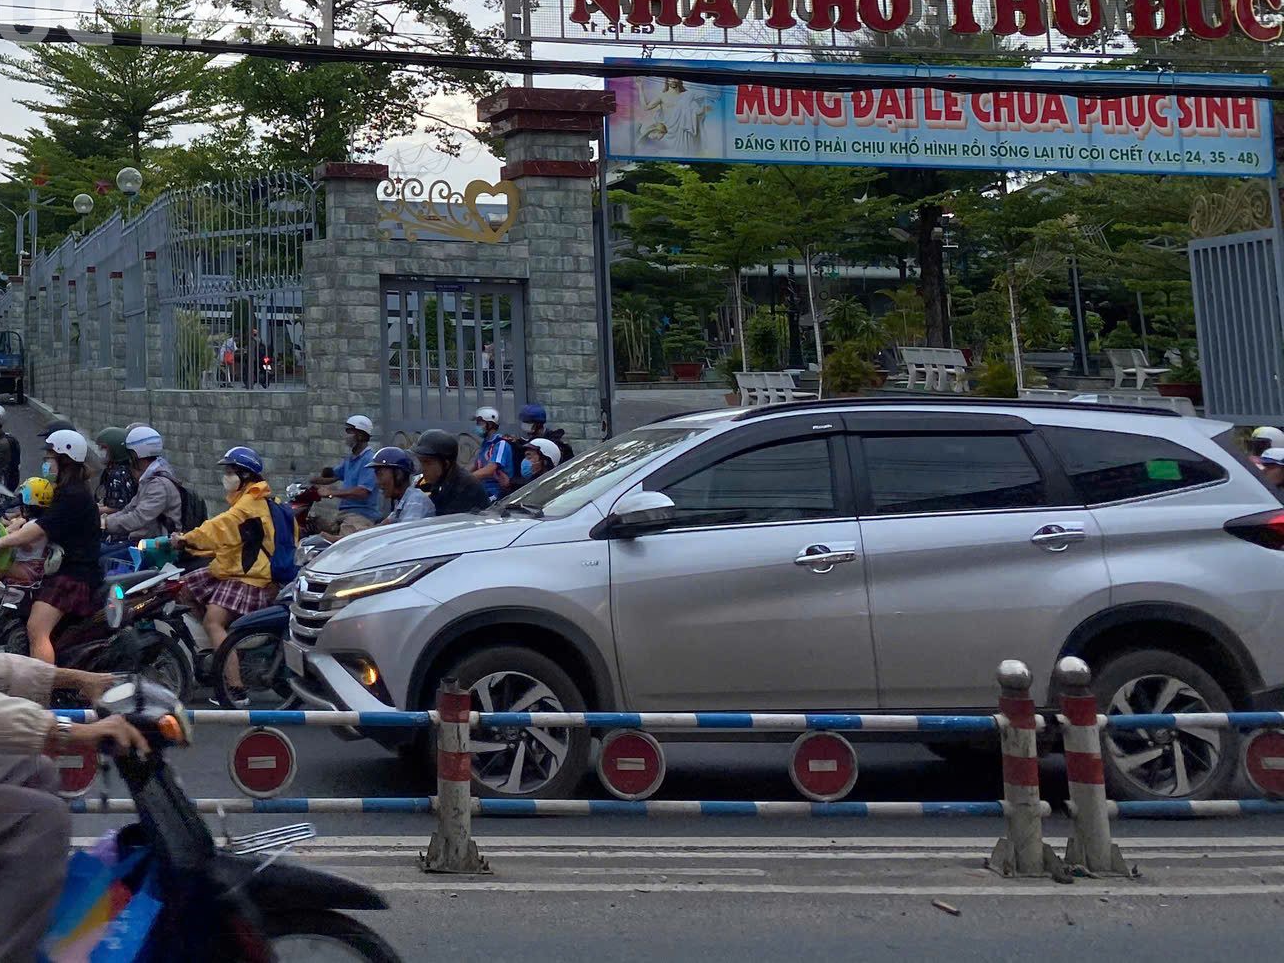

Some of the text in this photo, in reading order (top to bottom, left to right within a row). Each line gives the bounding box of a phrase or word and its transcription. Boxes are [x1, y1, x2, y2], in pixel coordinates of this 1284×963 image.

[850, 87, 914, 125] ĐẠI
[1077, 95, 1174, 132] PHỤC
[1178, 95, 1255, 129] SINH
[734, 133, 776, 151] ĐẤNG
[780, 137, 811, 152] KITÔ
[815, 135, 847, 153] PHẢI
[851, 139, 885, 158] CHỊU
[889, 135, 919, 155] KHỔ
[924, 139, 958, 156] HÌNH
[962, 137, 986, 157] RỒI
[990, 141, 1030, 158] SỐNG
[1034, 147, 1054, 163] LẠI
[1058, 144, 1075, 159] TỪ
[1079, 147, 1105, 160] CÕI
[1109, 144, 1144, 162] CHẾT
[1148, 148, 1182, 164] (x.Lc
[1185, 149, 1206, 164] 24,
[1210, 149, 1226, 163] 35
[1237, 150, 1260, 167] 48)
